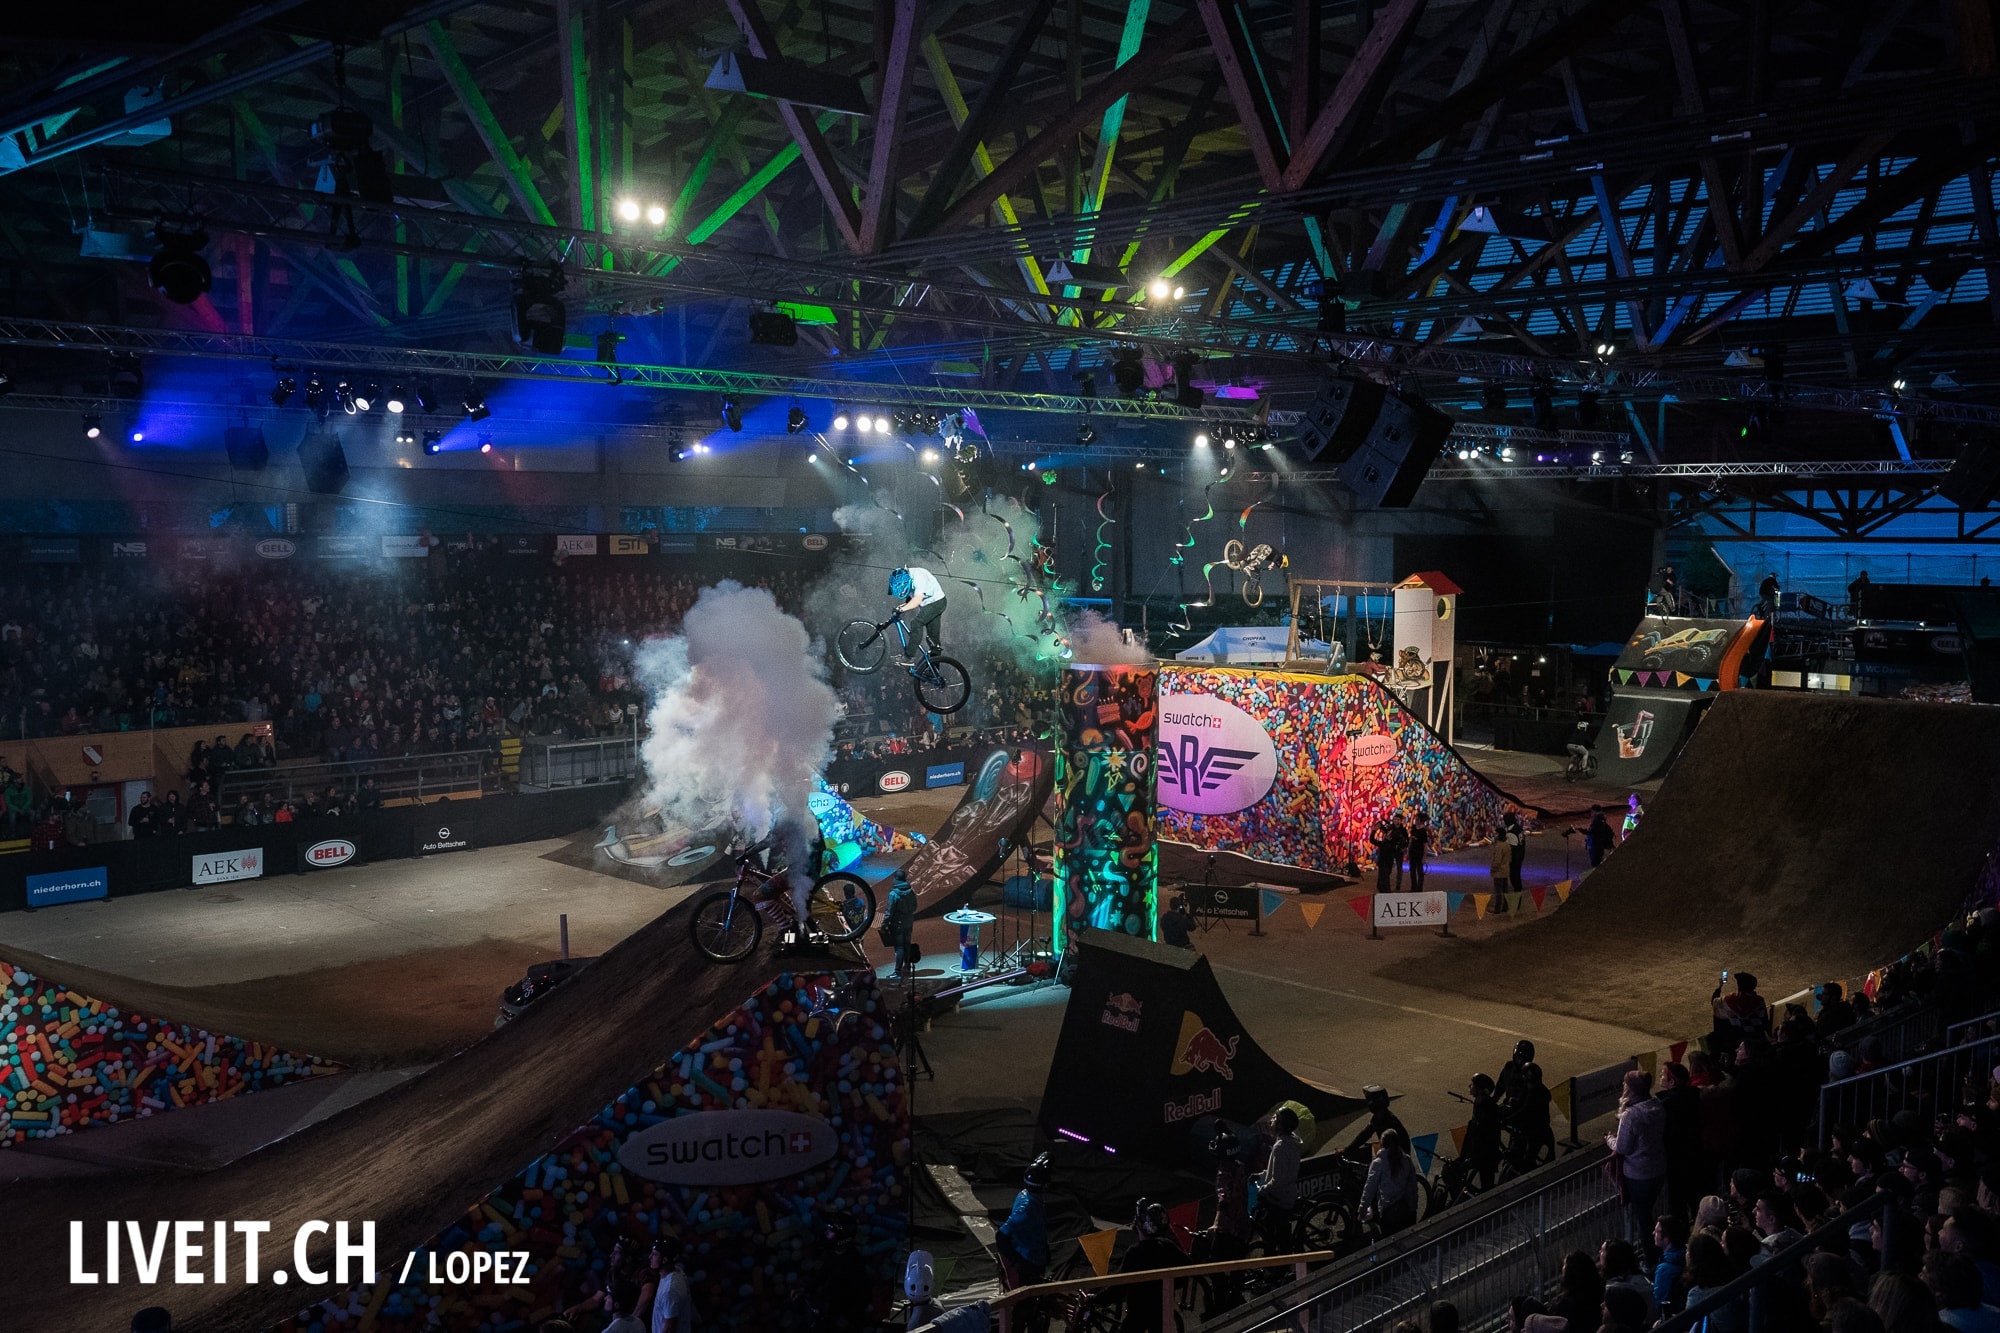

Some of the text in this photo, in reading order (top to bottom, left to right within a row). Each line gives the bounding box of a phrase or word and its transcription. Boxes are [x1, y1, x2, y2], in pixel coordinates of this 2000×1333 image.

[113, 542, 147, 553] NS
[263, 544, 290, 553] BELL
[561, 540, 584, 550] AEK
[715, 538, 736, 546] NS
[806, 538, 824, 546] BELL
[1163, 712, 1212, 728] swatch
[1352, 743, 1386, 757] swatch
[884, 775, 905, 787] BELL
[314, 846, 348, 860] BELL
[199, 858, 240, 876] AEK
[33, 879, 102, 895] niederhorn.ch
[1195, 906, 1213, 914] Auo
[1381, 901, 1422, 918] AEK
[647, 1130, 787, 1166] swatch
